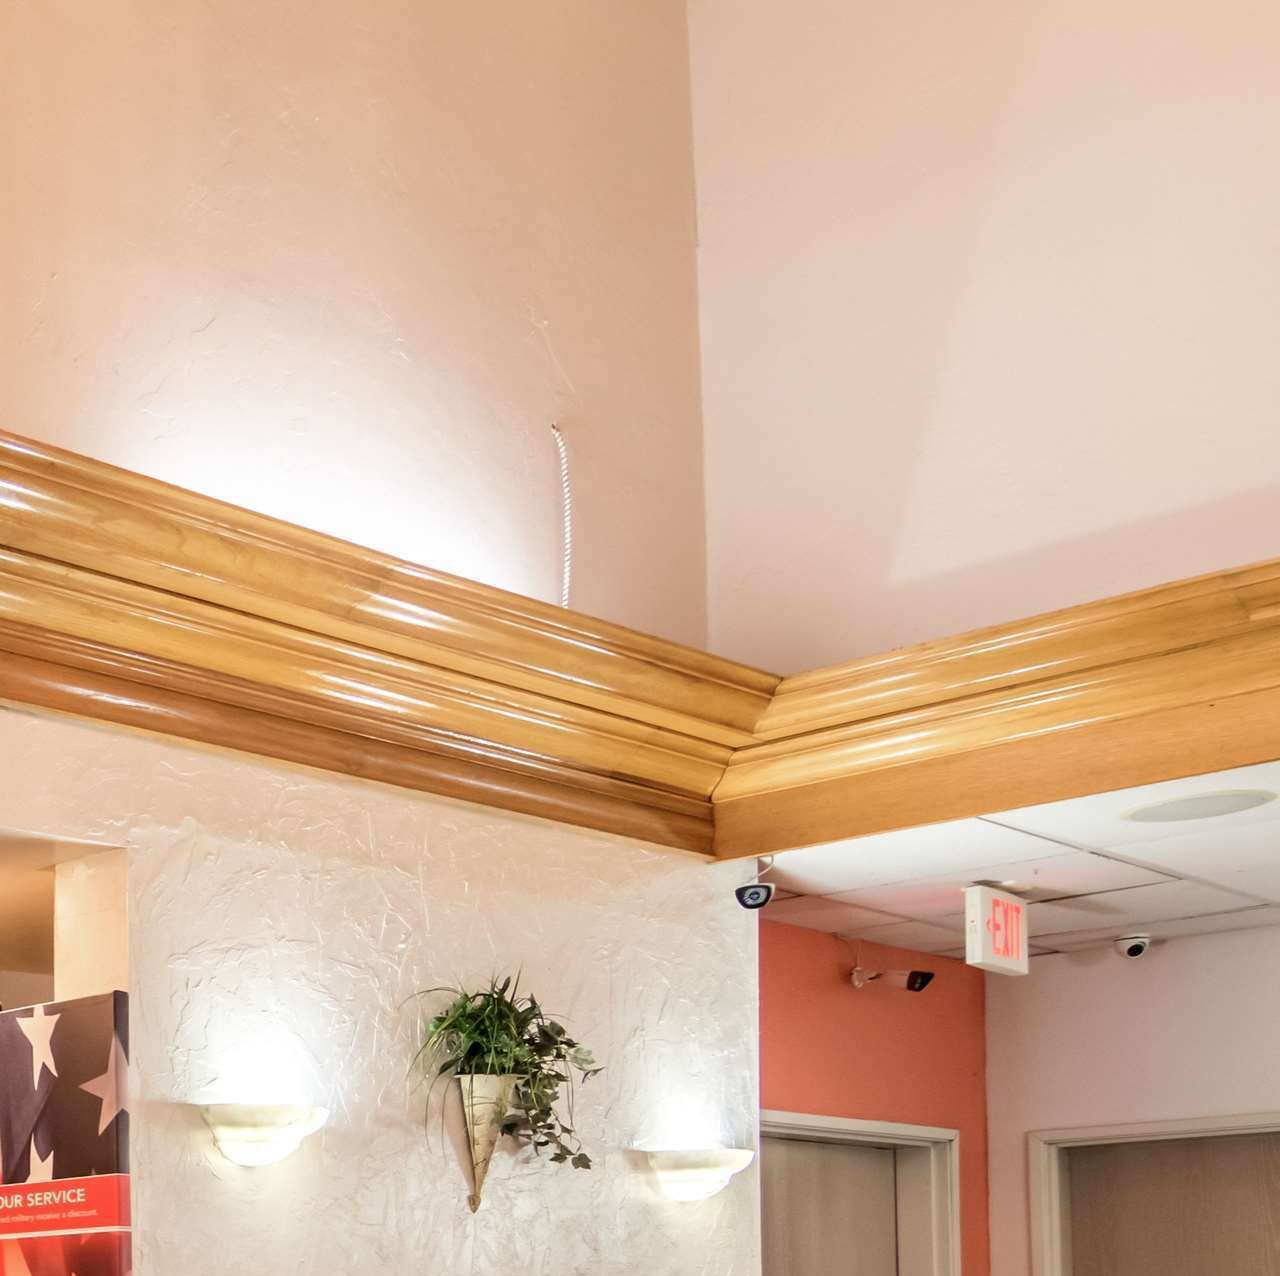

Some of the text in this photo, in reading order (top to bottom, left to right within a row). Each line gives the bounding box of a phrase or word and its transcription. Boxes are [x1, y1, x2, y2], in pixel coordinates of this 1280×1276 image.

[992, 898, 1022, 960] EXIT
[27, 1188, 87, 1207] SERVICE
[11, 1213, 35, 1224] military
